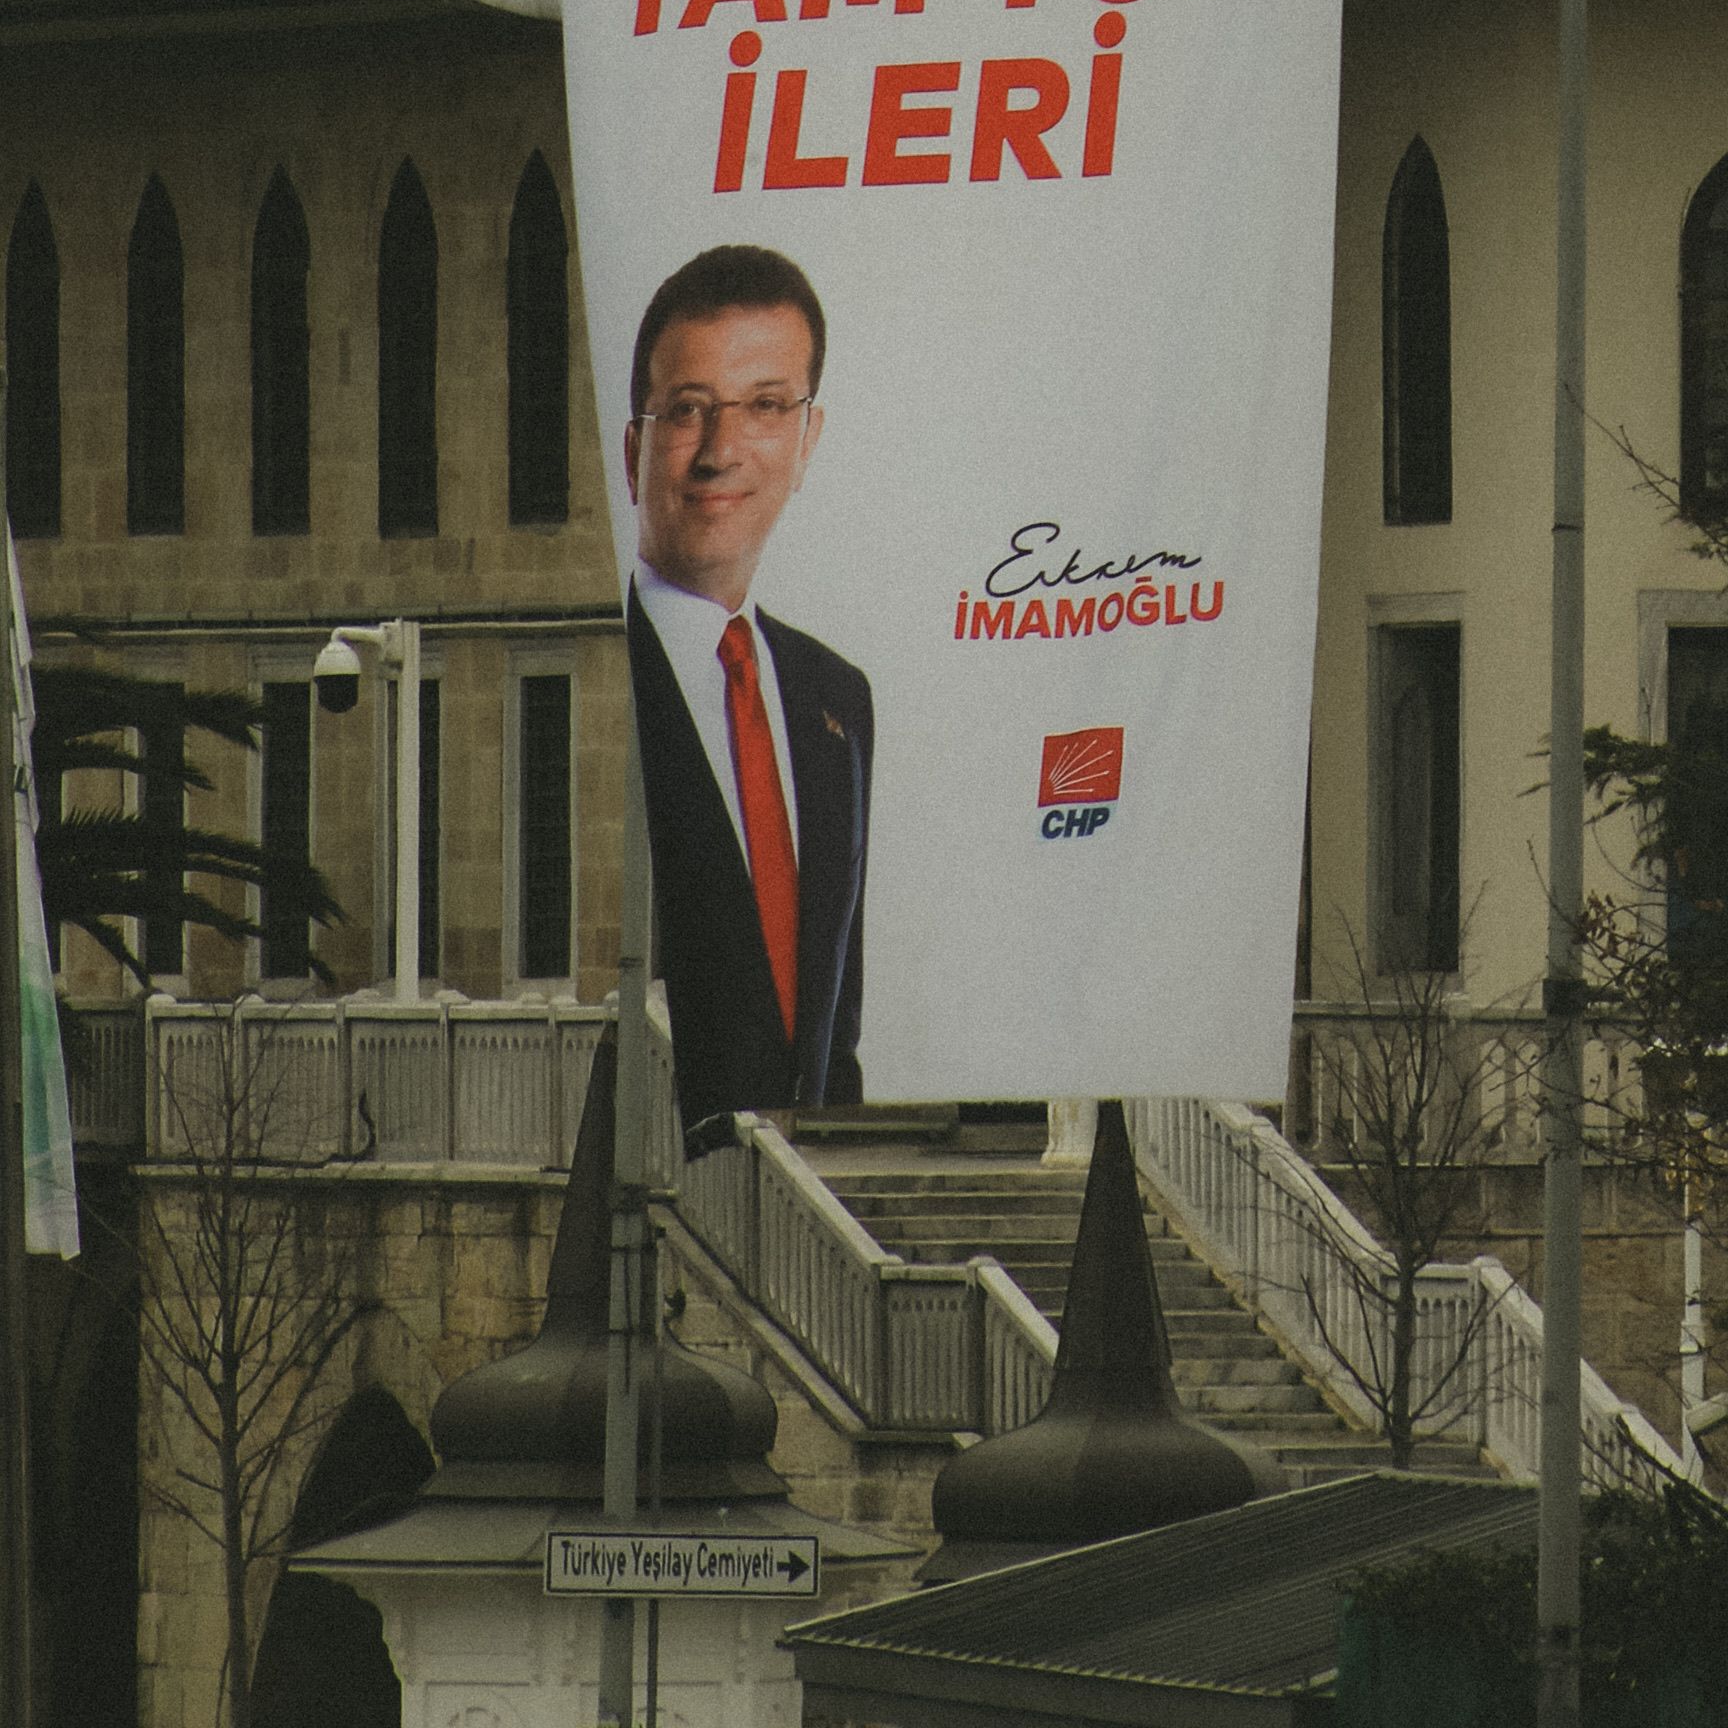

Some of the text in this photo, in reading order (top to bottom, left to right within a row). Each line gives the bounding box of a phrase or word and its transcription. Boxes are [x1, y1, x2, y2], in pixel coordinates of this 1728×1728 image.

[712, 10, 1127, 194] İLERİ
[984, 520, 1203, 601] Ekrem
[952, 575, 1226, 642] İMAMOĞLU
[1039, 805, 1113, 842] CHP
[561, 1539, 775, 1587] Türkiye Yeşilay Cemiyeti
